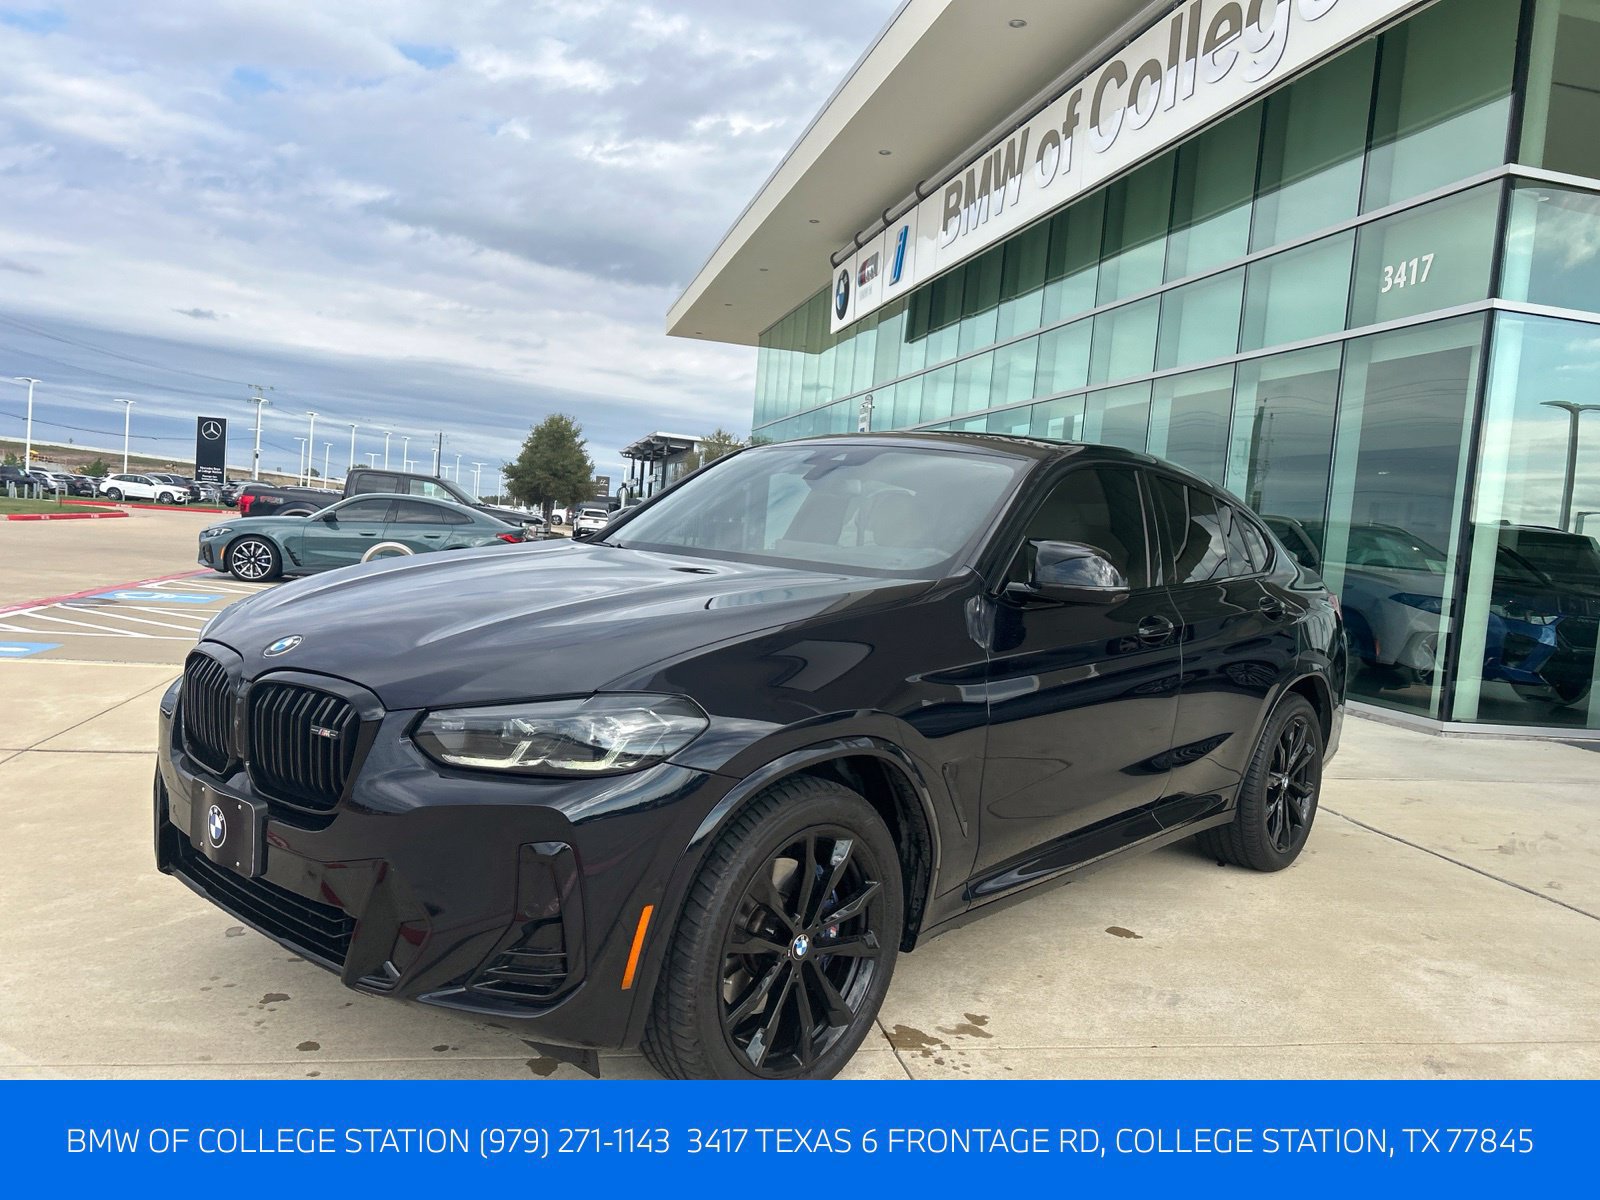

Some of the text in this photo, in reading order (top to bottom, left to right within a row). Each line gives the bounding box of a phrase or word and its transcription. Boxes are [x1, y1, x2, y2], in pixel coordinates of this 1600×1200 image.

[941, 127, 1030, 249] BMW
[1035, 88, 1082, 189] of
[1381, 253, 1434, 293] 3417
